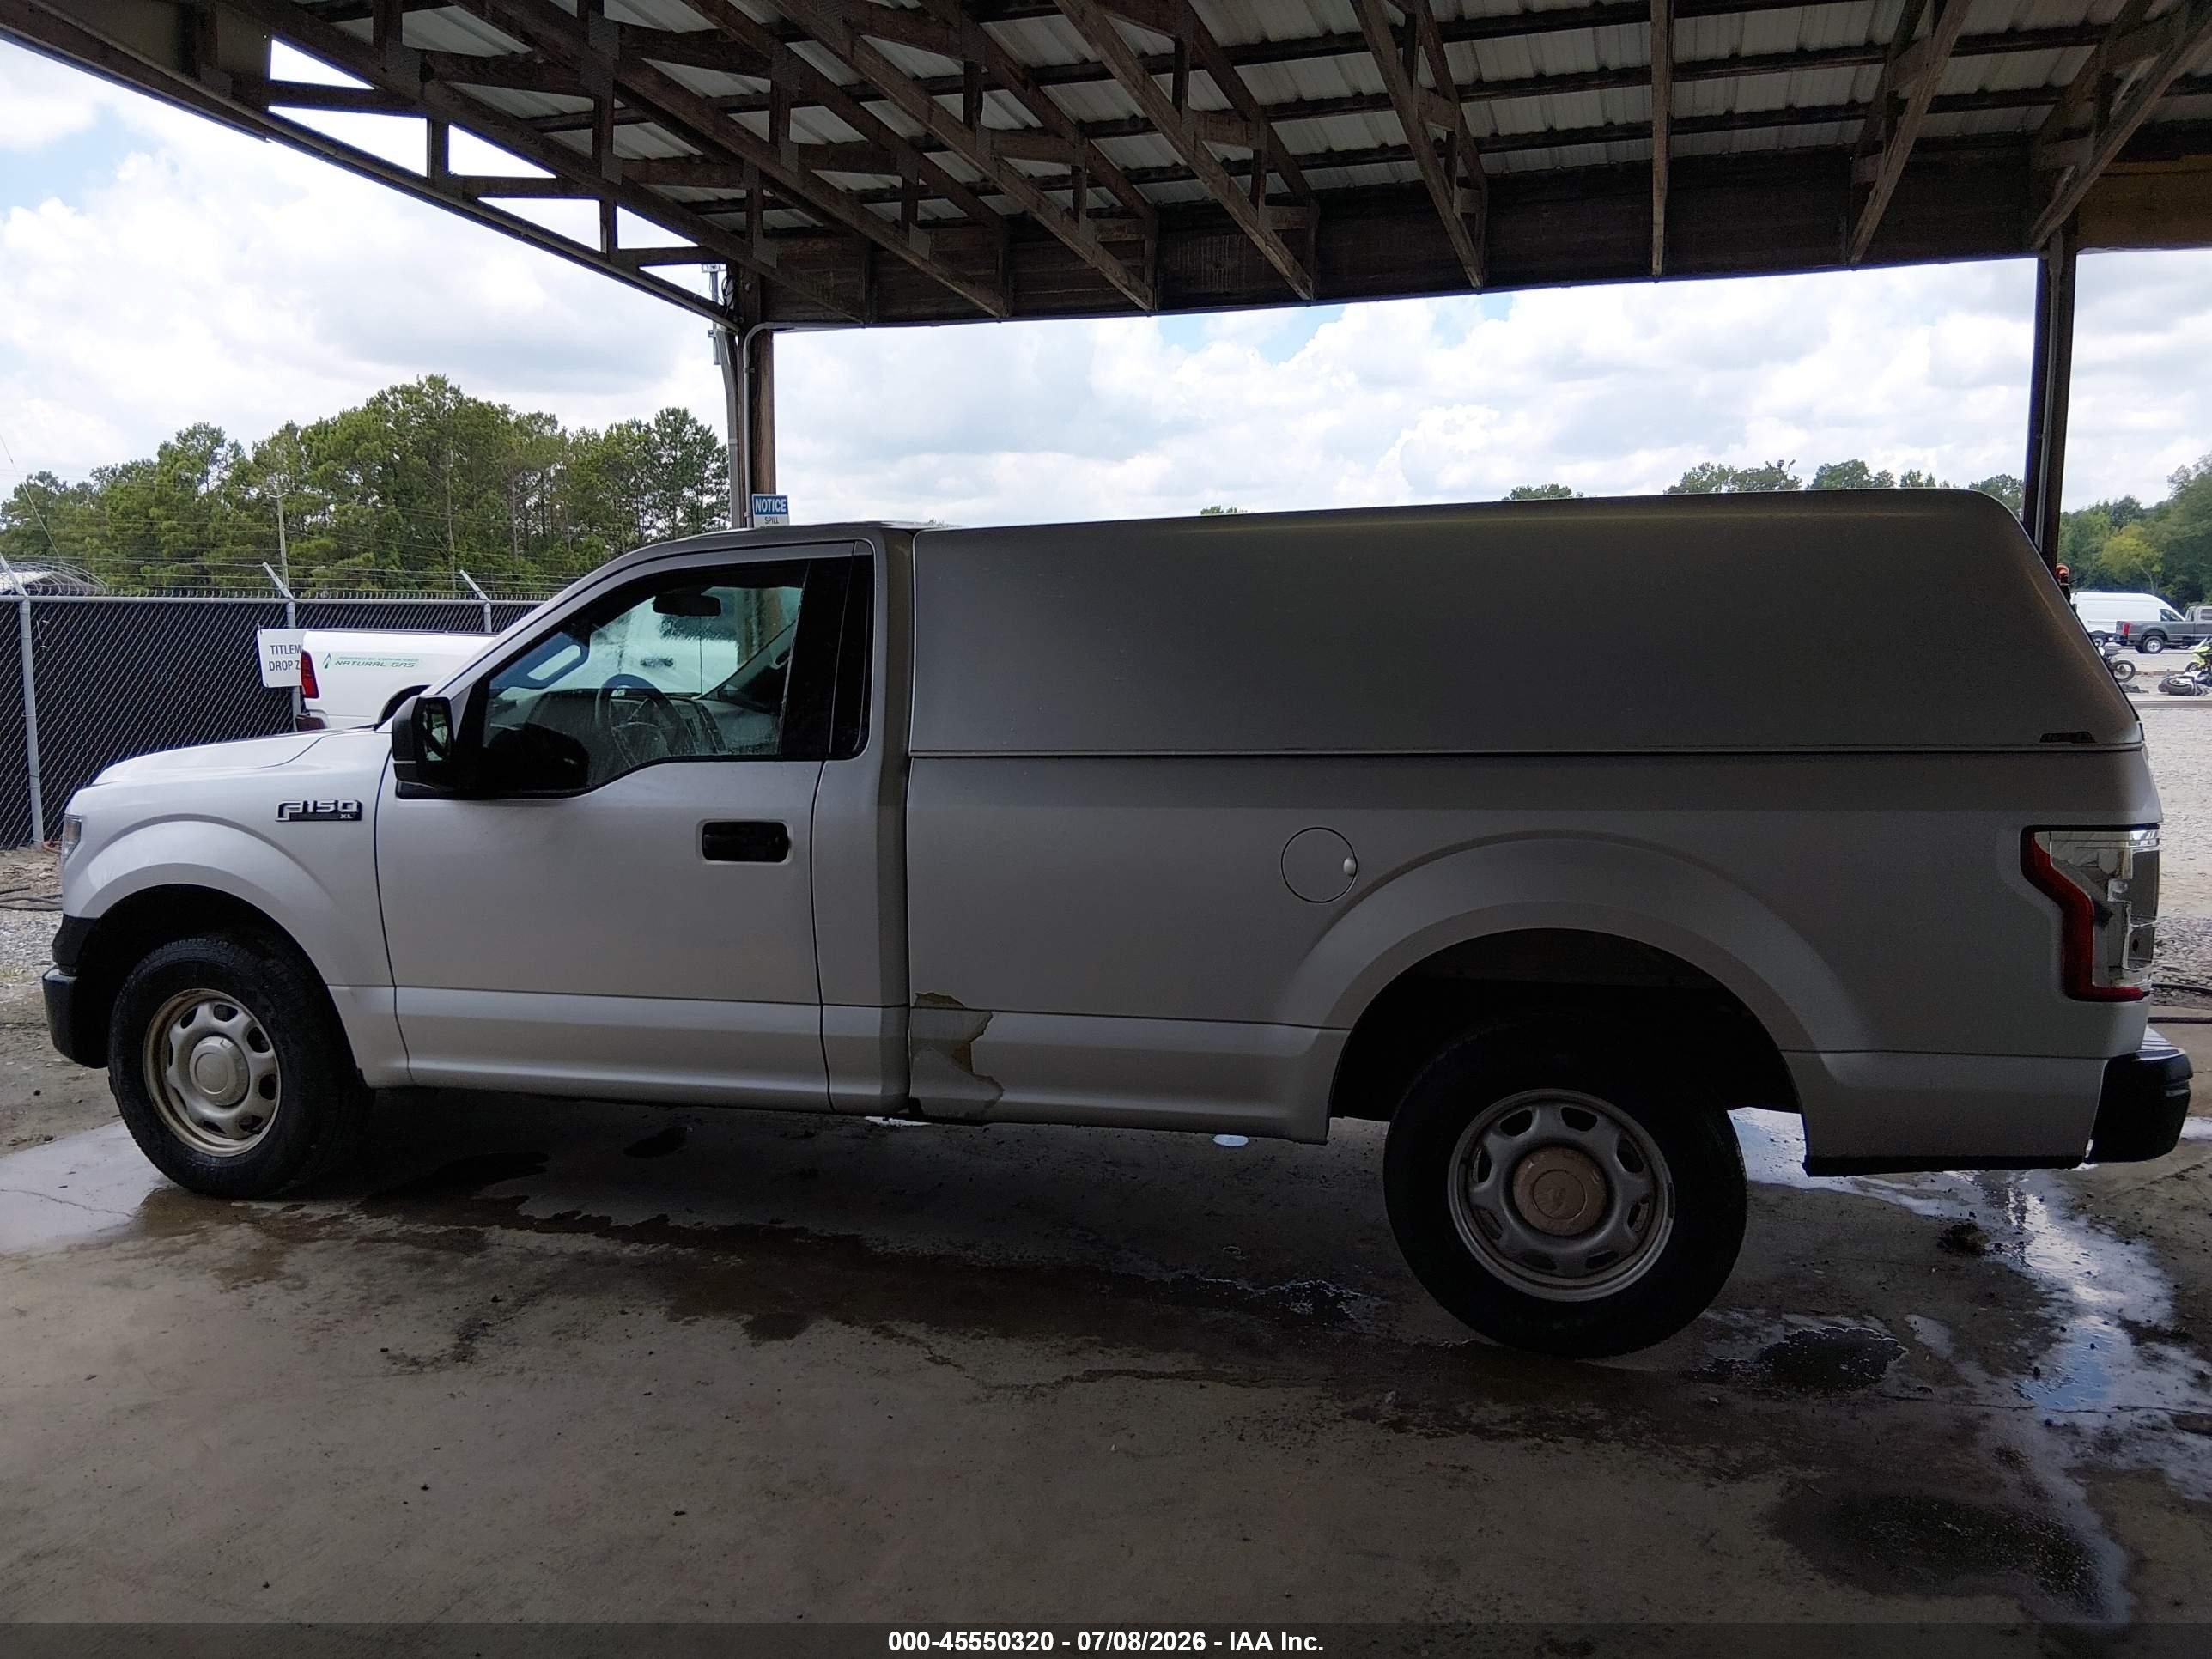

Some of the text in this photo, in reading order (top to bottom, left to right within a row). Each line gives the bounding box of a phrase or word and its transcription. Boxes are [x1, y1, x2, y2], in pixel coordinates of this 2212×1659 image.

[756, 498, 787, 513] NOTICE
[764, 516, 779, 525] SPILL
[268, 659, 294, 672] DROP
